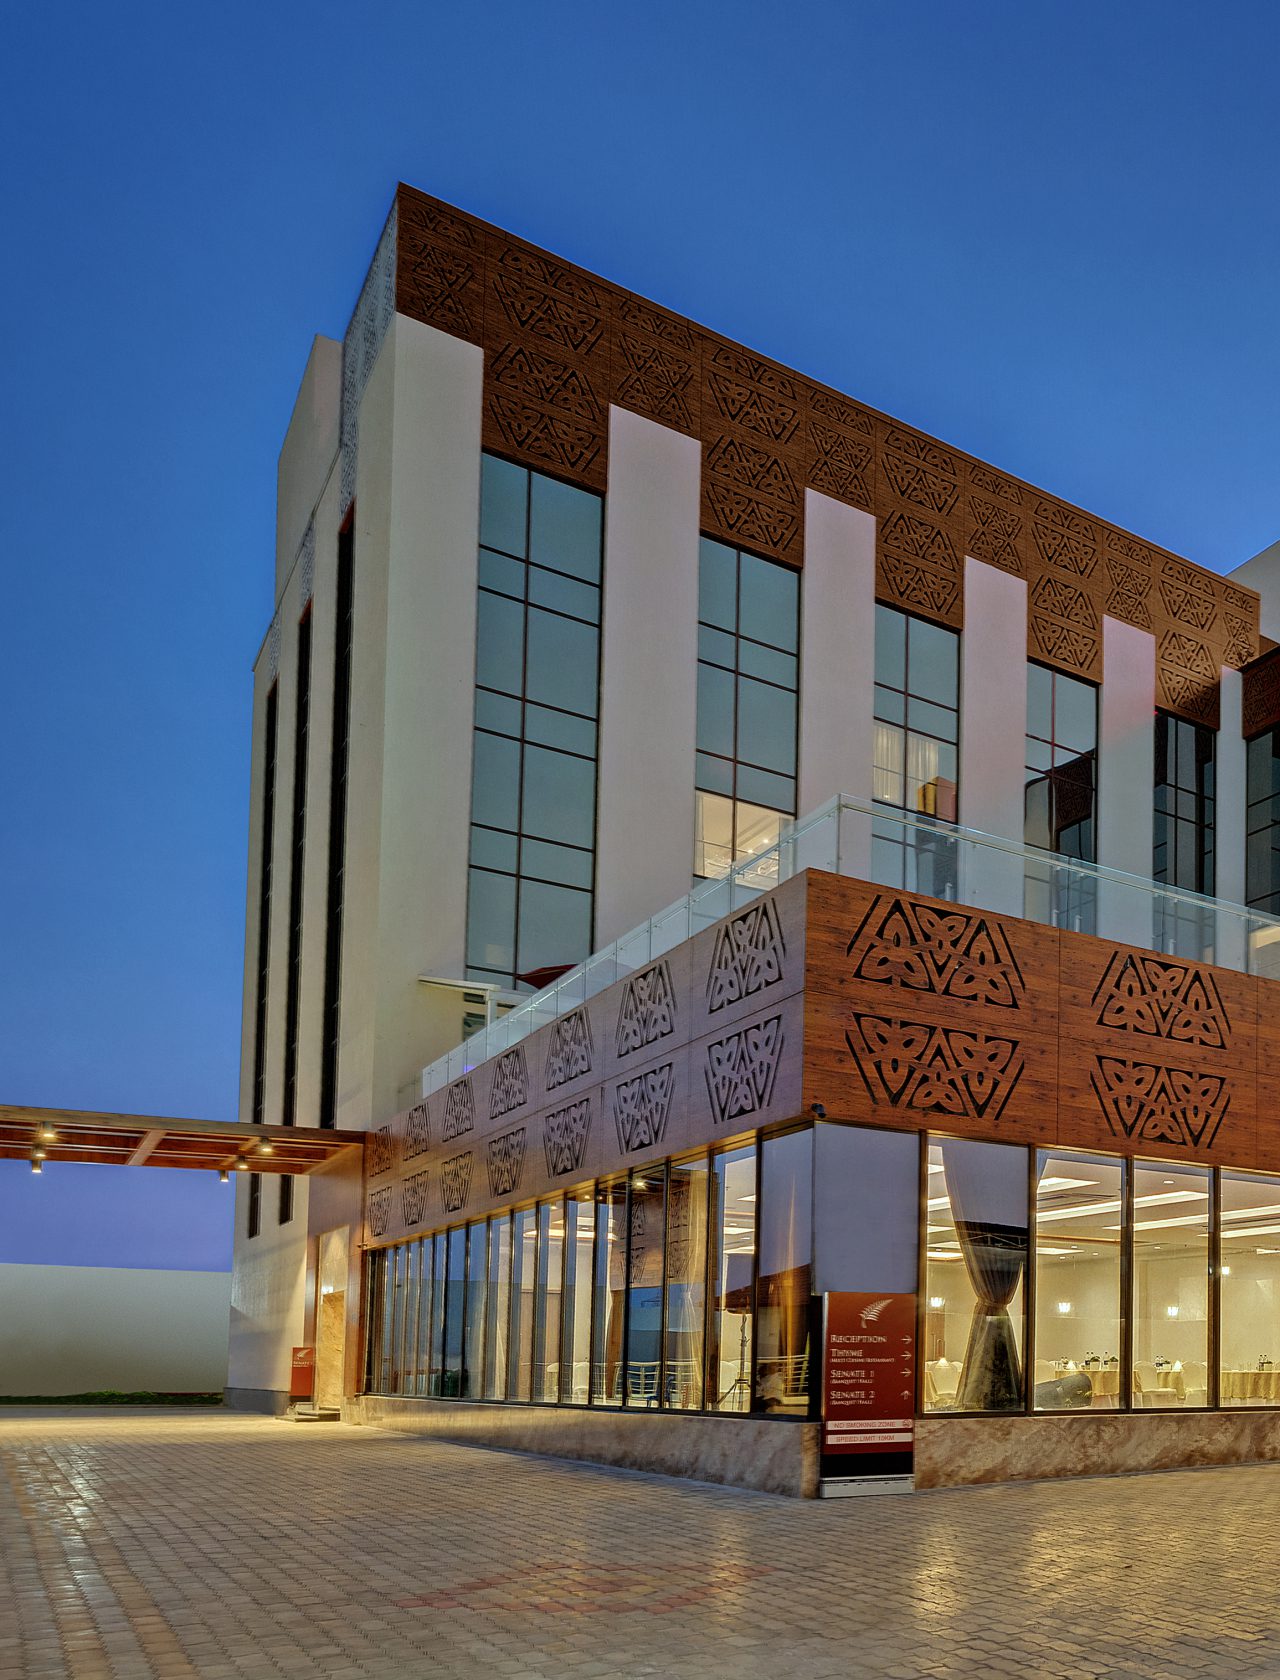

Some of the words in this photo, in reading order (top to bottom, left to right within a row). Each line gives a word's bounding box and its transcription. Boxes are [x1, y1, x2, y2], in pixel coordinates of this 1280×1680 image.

[830, 1335, 887, 1343] RECEPTION
[830, 1349, 863, 1357] THYME
[830, 1370, 865, 1378] SENATE
[830, 1391, 865, 1399] SENATE
[869, 1391, 876, 1399] 2
